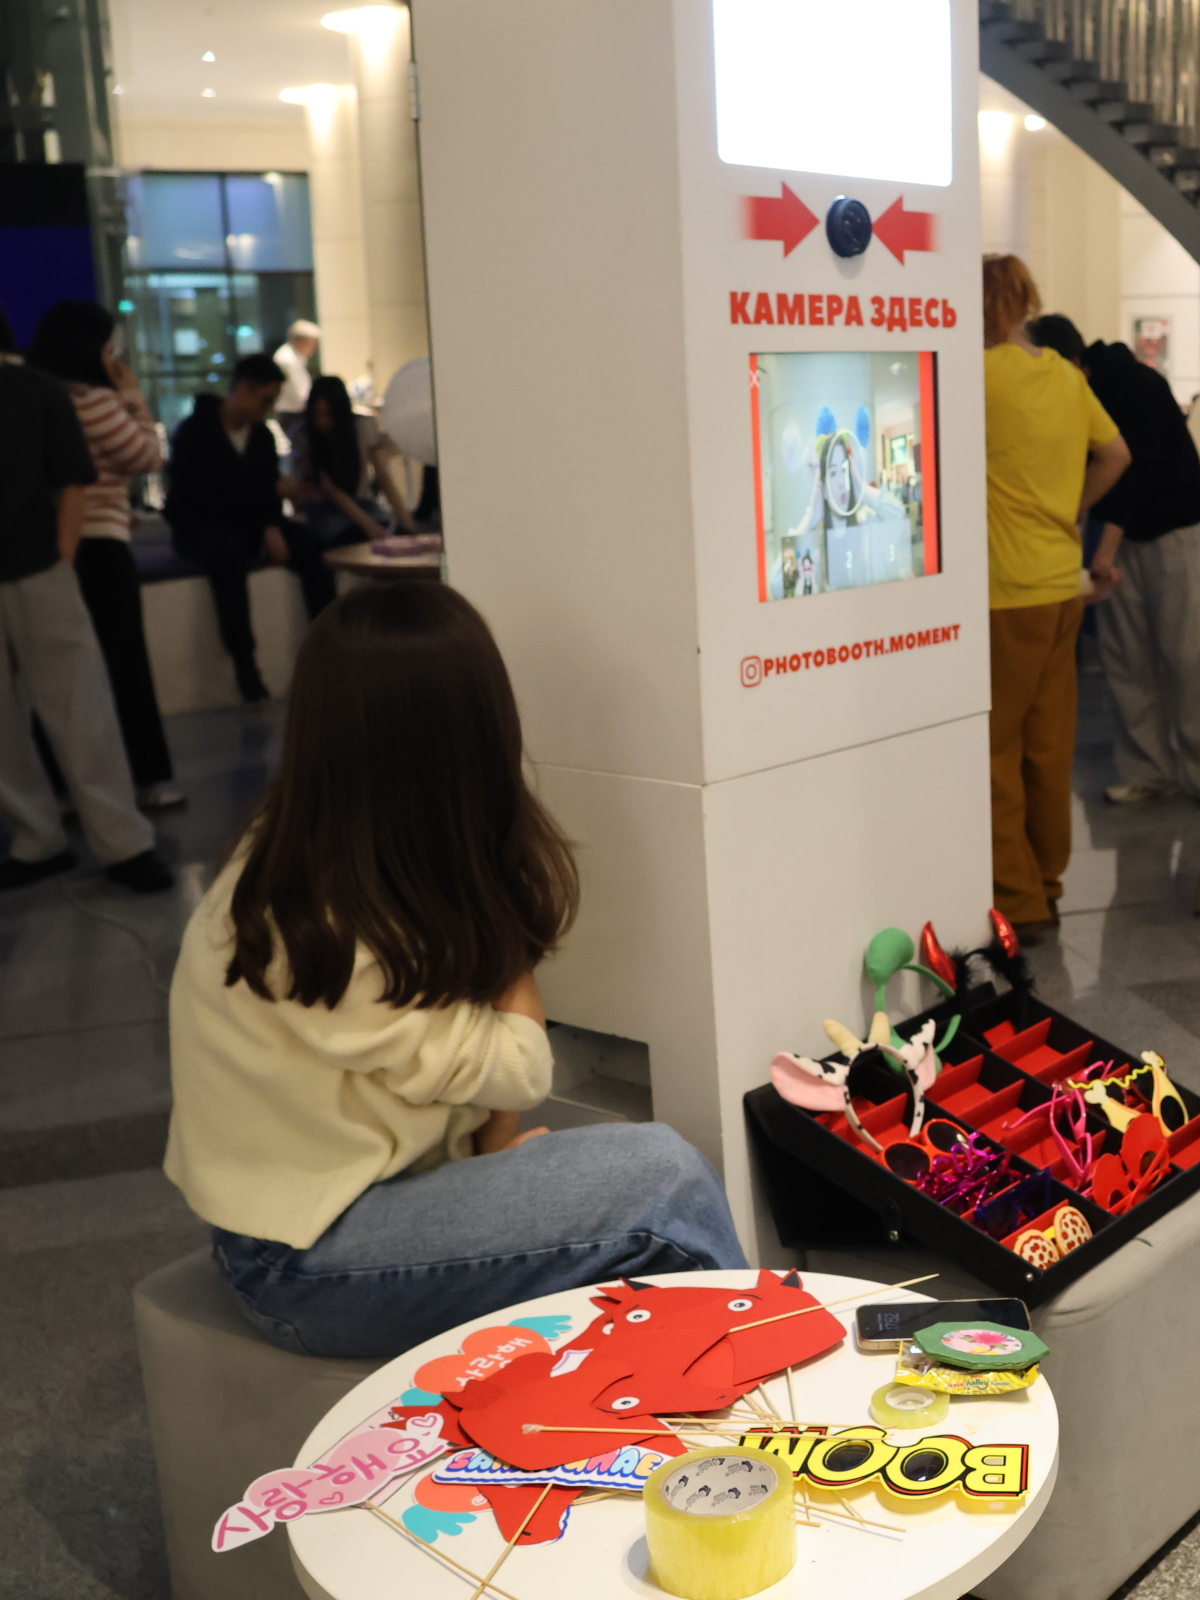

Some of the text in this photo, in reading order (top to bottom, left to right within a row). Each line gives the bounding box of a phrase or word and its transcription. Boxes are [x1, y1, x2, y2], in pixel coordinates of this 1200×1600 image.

[730, 291, 958, 332] КАМЕРА ЗДЕСЬ
[763, 624, 961, 677] PHOTOBOOTH.MOMENT
[216, 1436, 445, 1550] 사랑해요
